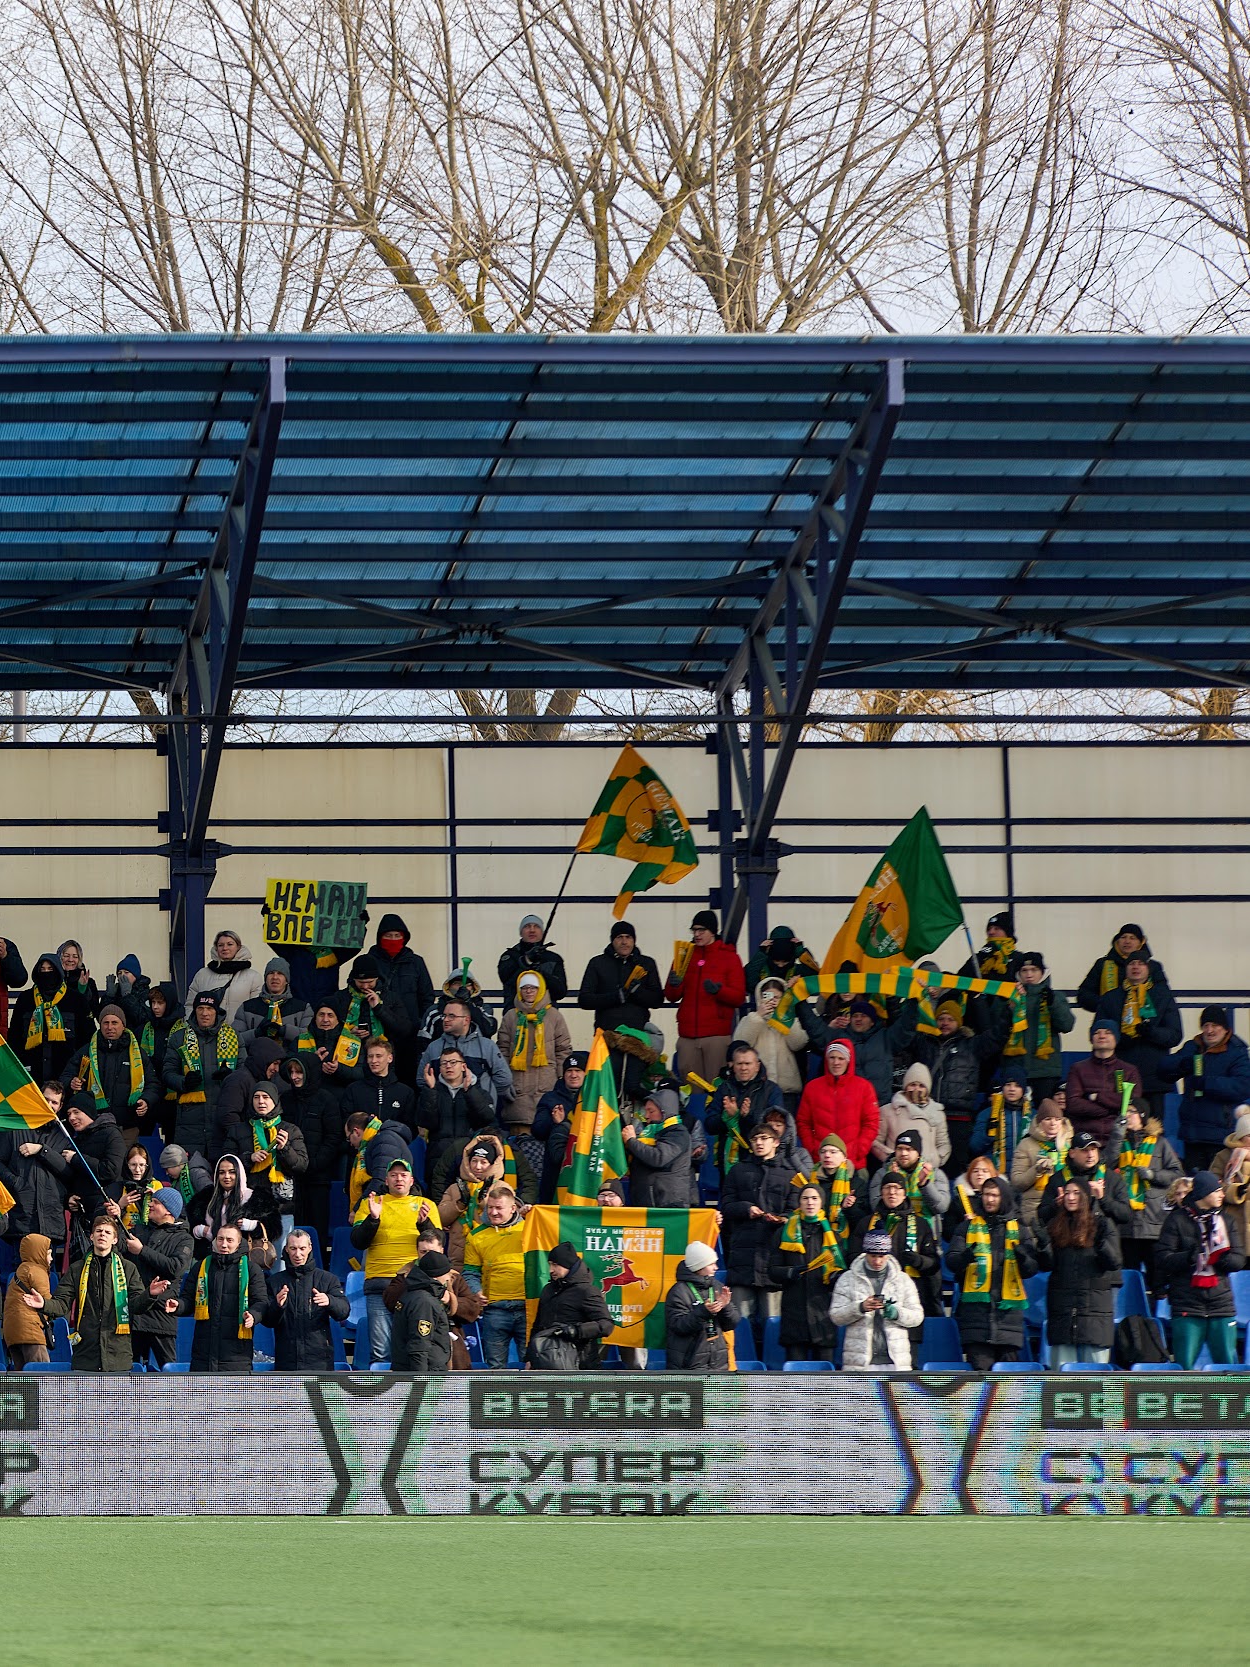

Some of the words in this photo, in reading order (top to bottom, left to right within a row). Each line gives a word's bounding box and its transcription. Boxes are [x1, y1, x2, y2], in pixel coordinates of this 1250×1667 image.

[273, 882, 365, 917] НЕМАН
[266, 913, 365, 946] ВПЕРЕД
[483, 1392, 691, 1418] BET.ERA
[469, 1450, 704, 1483] СУПЕР
